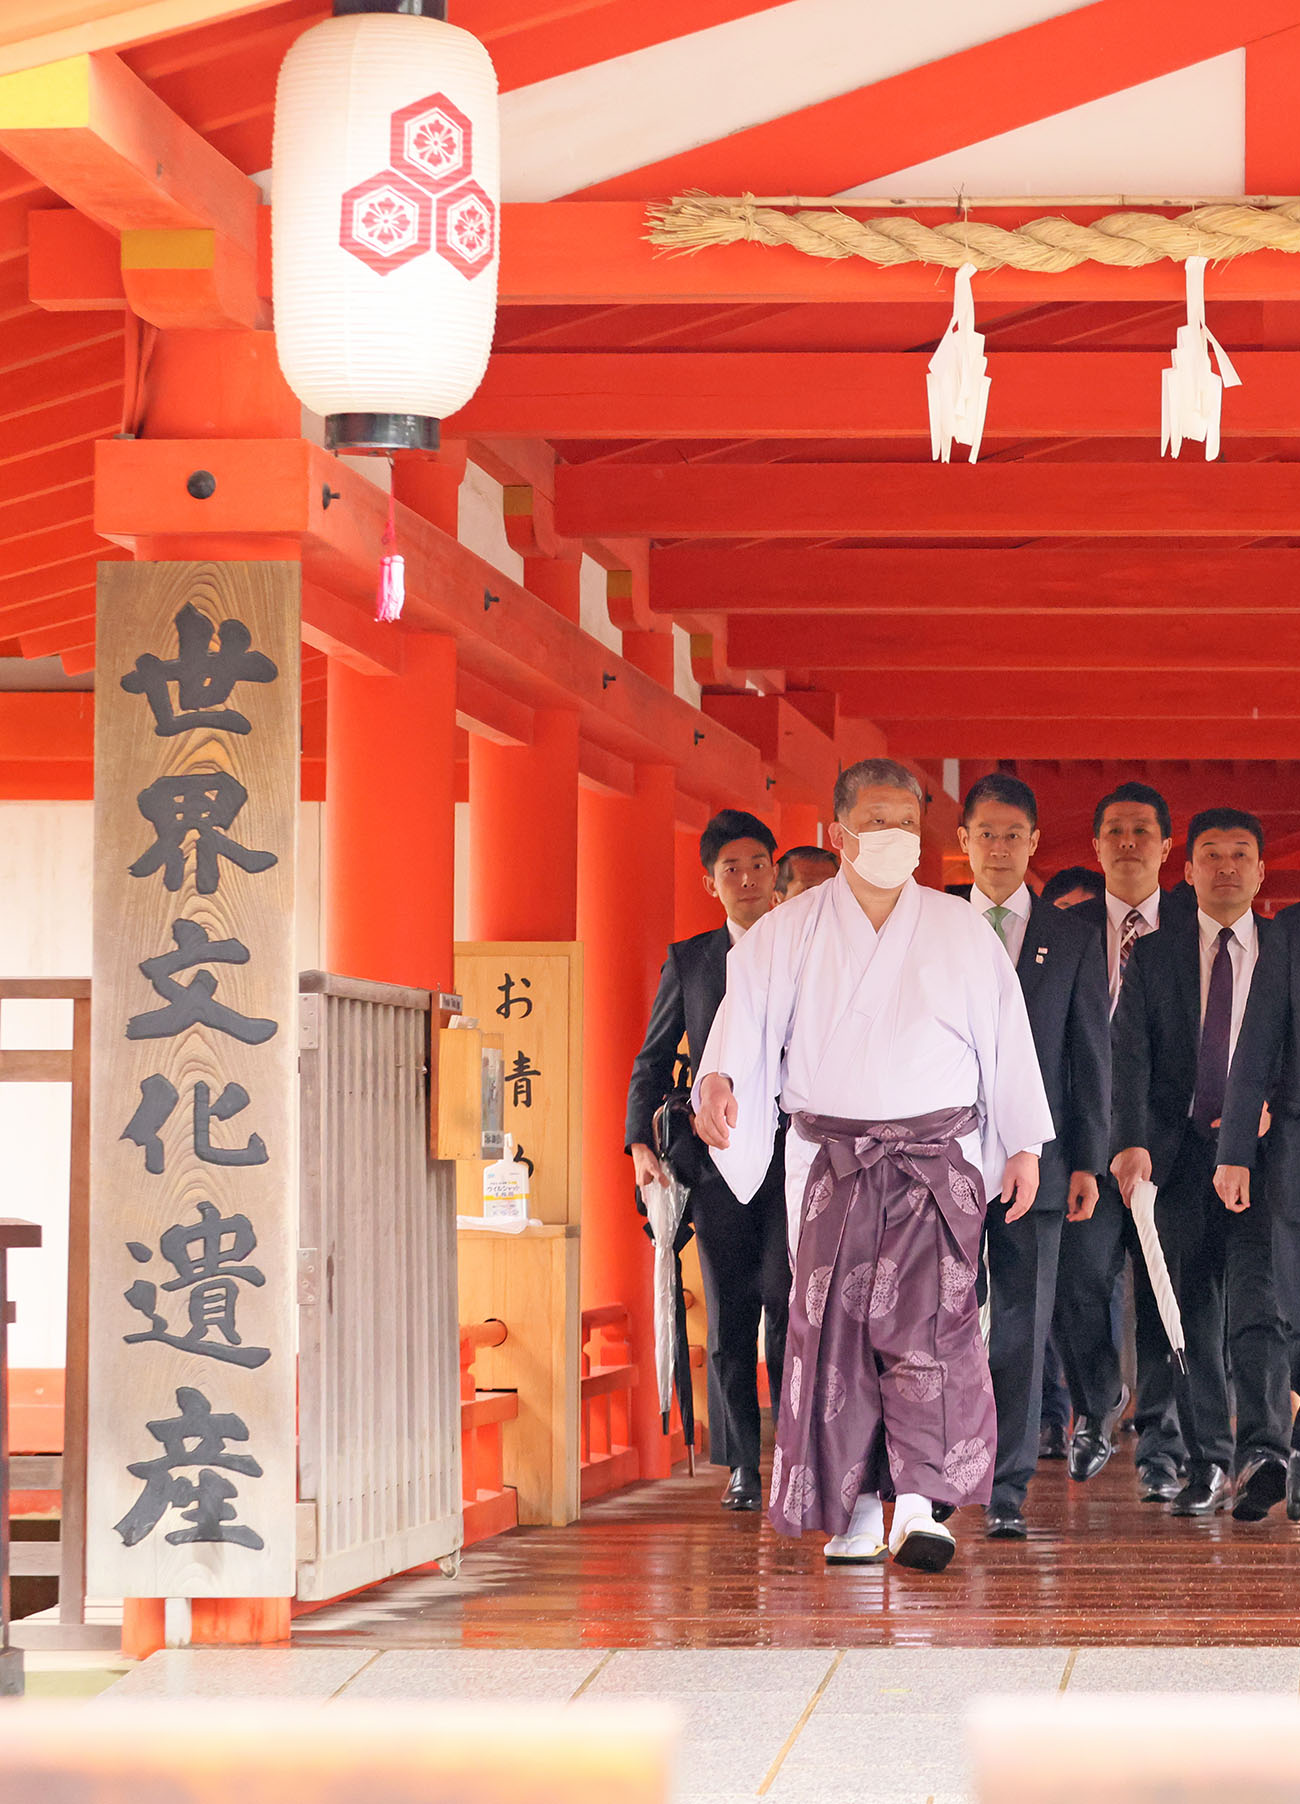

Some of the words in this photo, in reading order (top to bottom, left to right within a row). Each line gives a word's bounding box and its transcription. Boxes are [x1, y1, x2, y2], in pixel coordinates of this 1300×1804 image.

[112, 601, 279, 1550] 世界文化遺産
